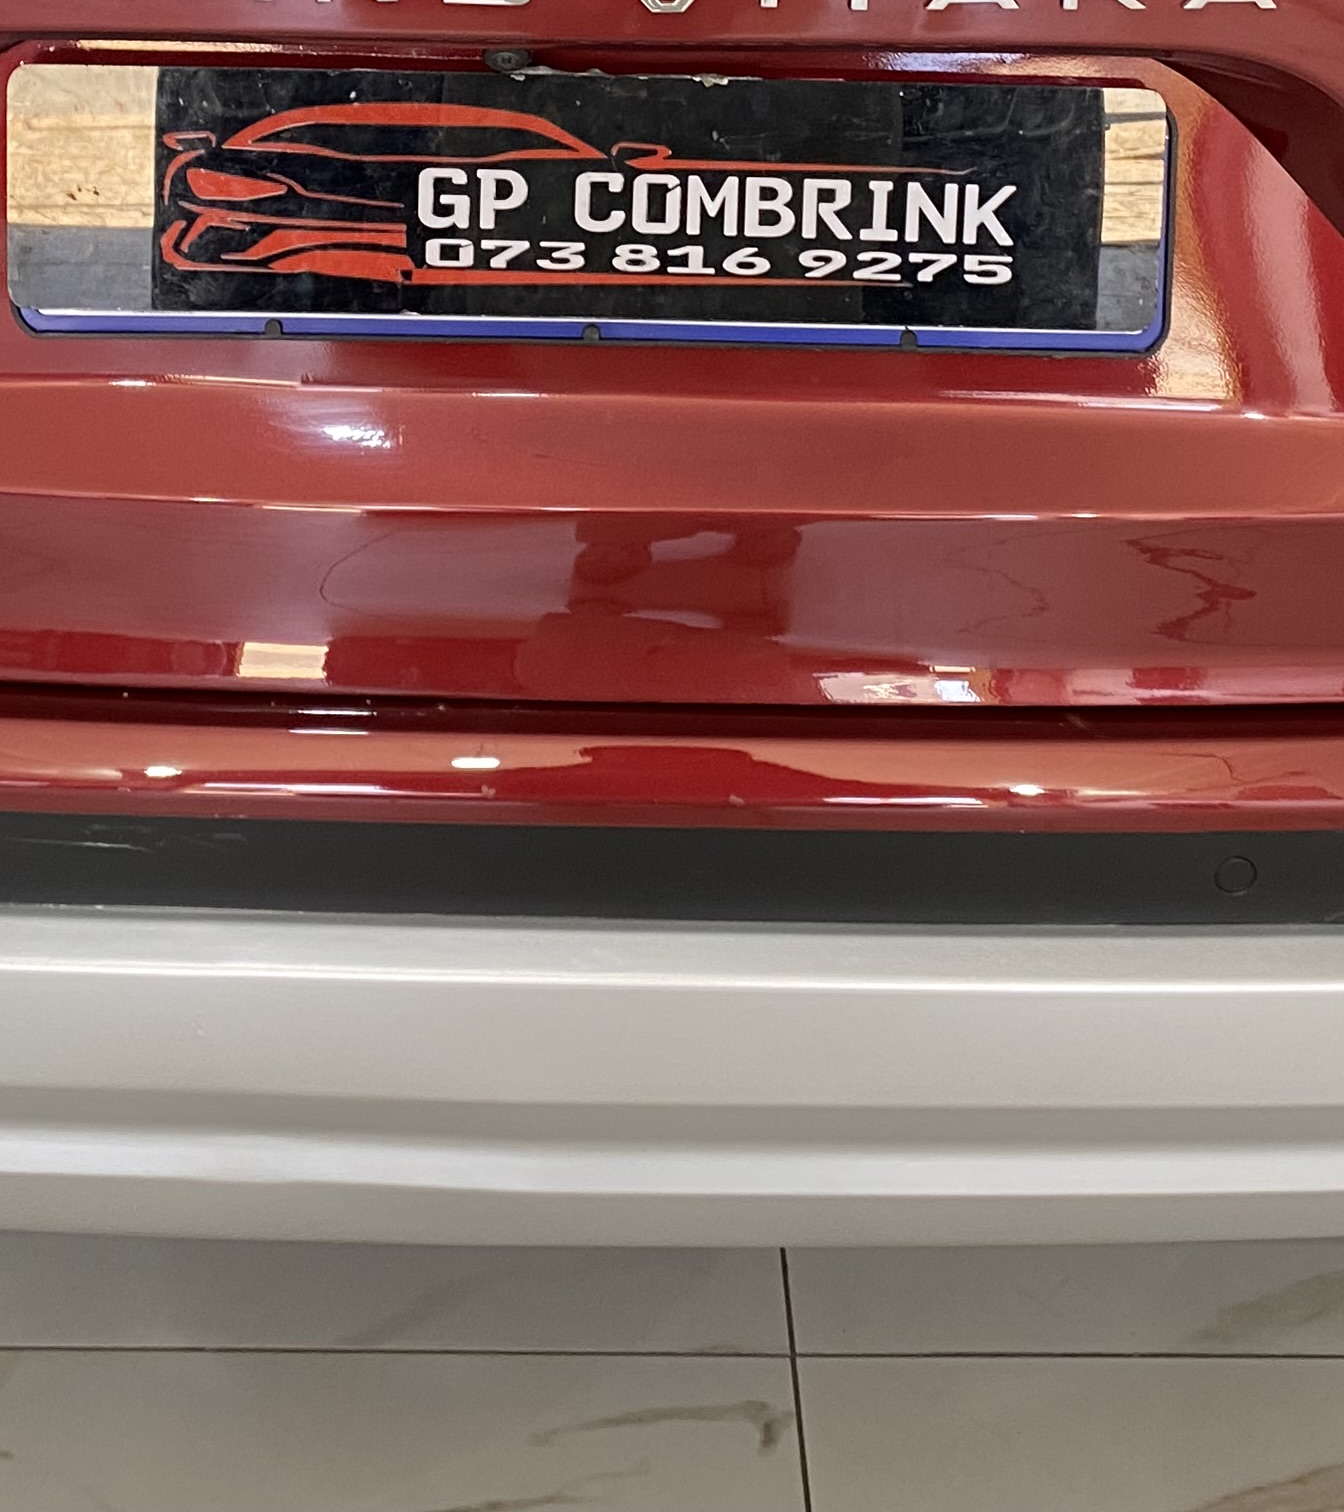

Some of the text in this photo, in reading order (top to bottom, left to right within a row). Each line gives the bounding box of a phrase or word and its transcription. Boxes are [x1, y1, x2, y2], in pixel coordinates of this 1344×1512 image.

[417, 167, 1017, 246] GP COMBRINK
[425, 238, 1014, 285] 073 816 9275
